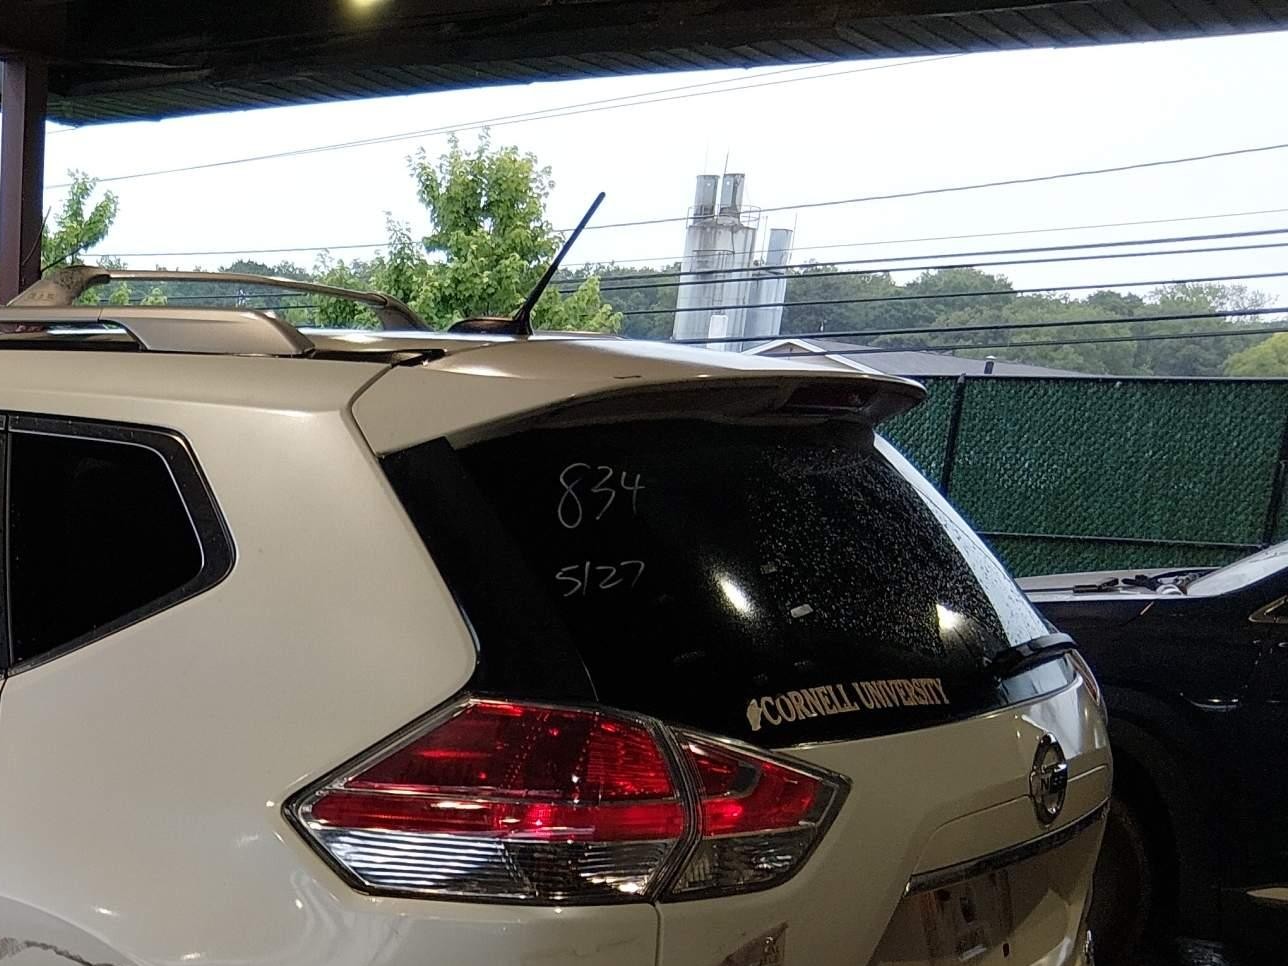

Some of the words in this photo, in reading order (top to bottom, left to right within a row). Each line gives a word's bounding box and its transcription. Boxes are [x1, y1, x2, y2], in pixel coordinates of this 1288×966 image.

[558, 462, 646, 529] 834
[761, 684, 860, 726] CORNELL
[852, 678, 949, 709] UNIVERSITY
